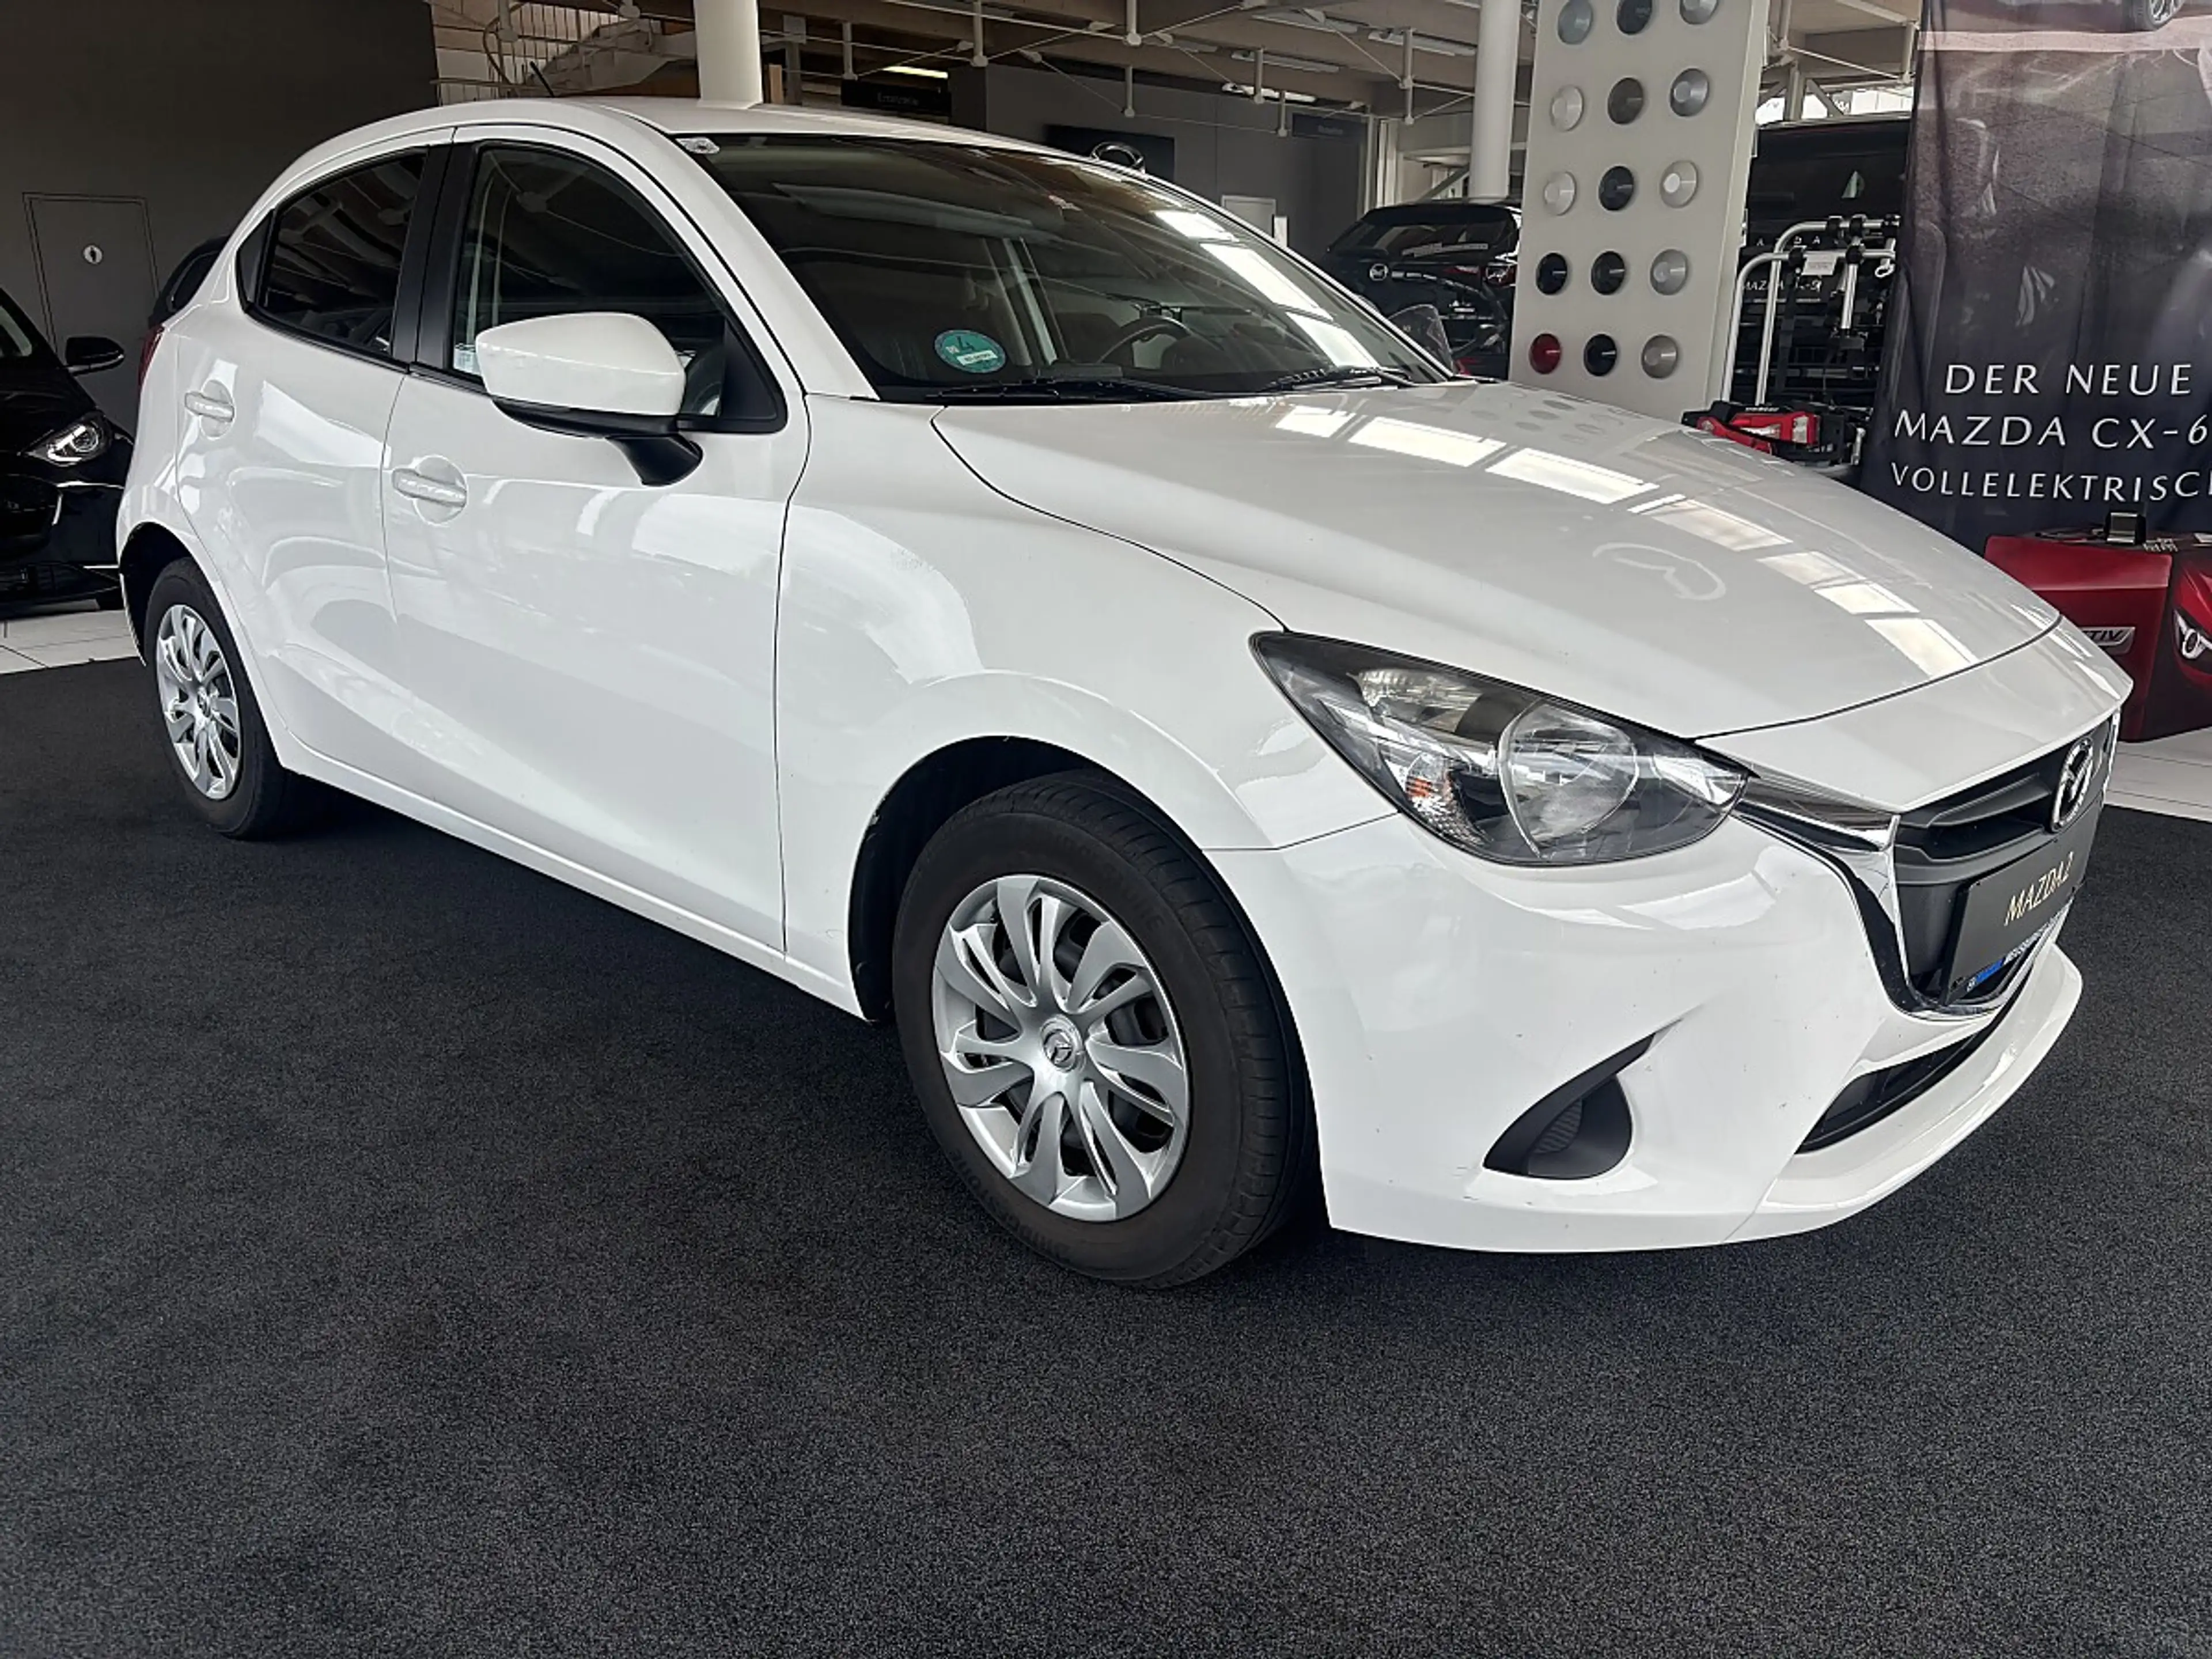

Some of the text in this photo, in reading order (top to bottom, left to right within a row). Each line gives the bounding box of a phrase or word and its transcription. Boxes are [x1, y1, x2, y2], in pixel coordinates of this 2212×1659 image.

[1944, 363, 2192, 396] DER NEUE
[1894, 409, 2208, 449] MAZDA CX-6
